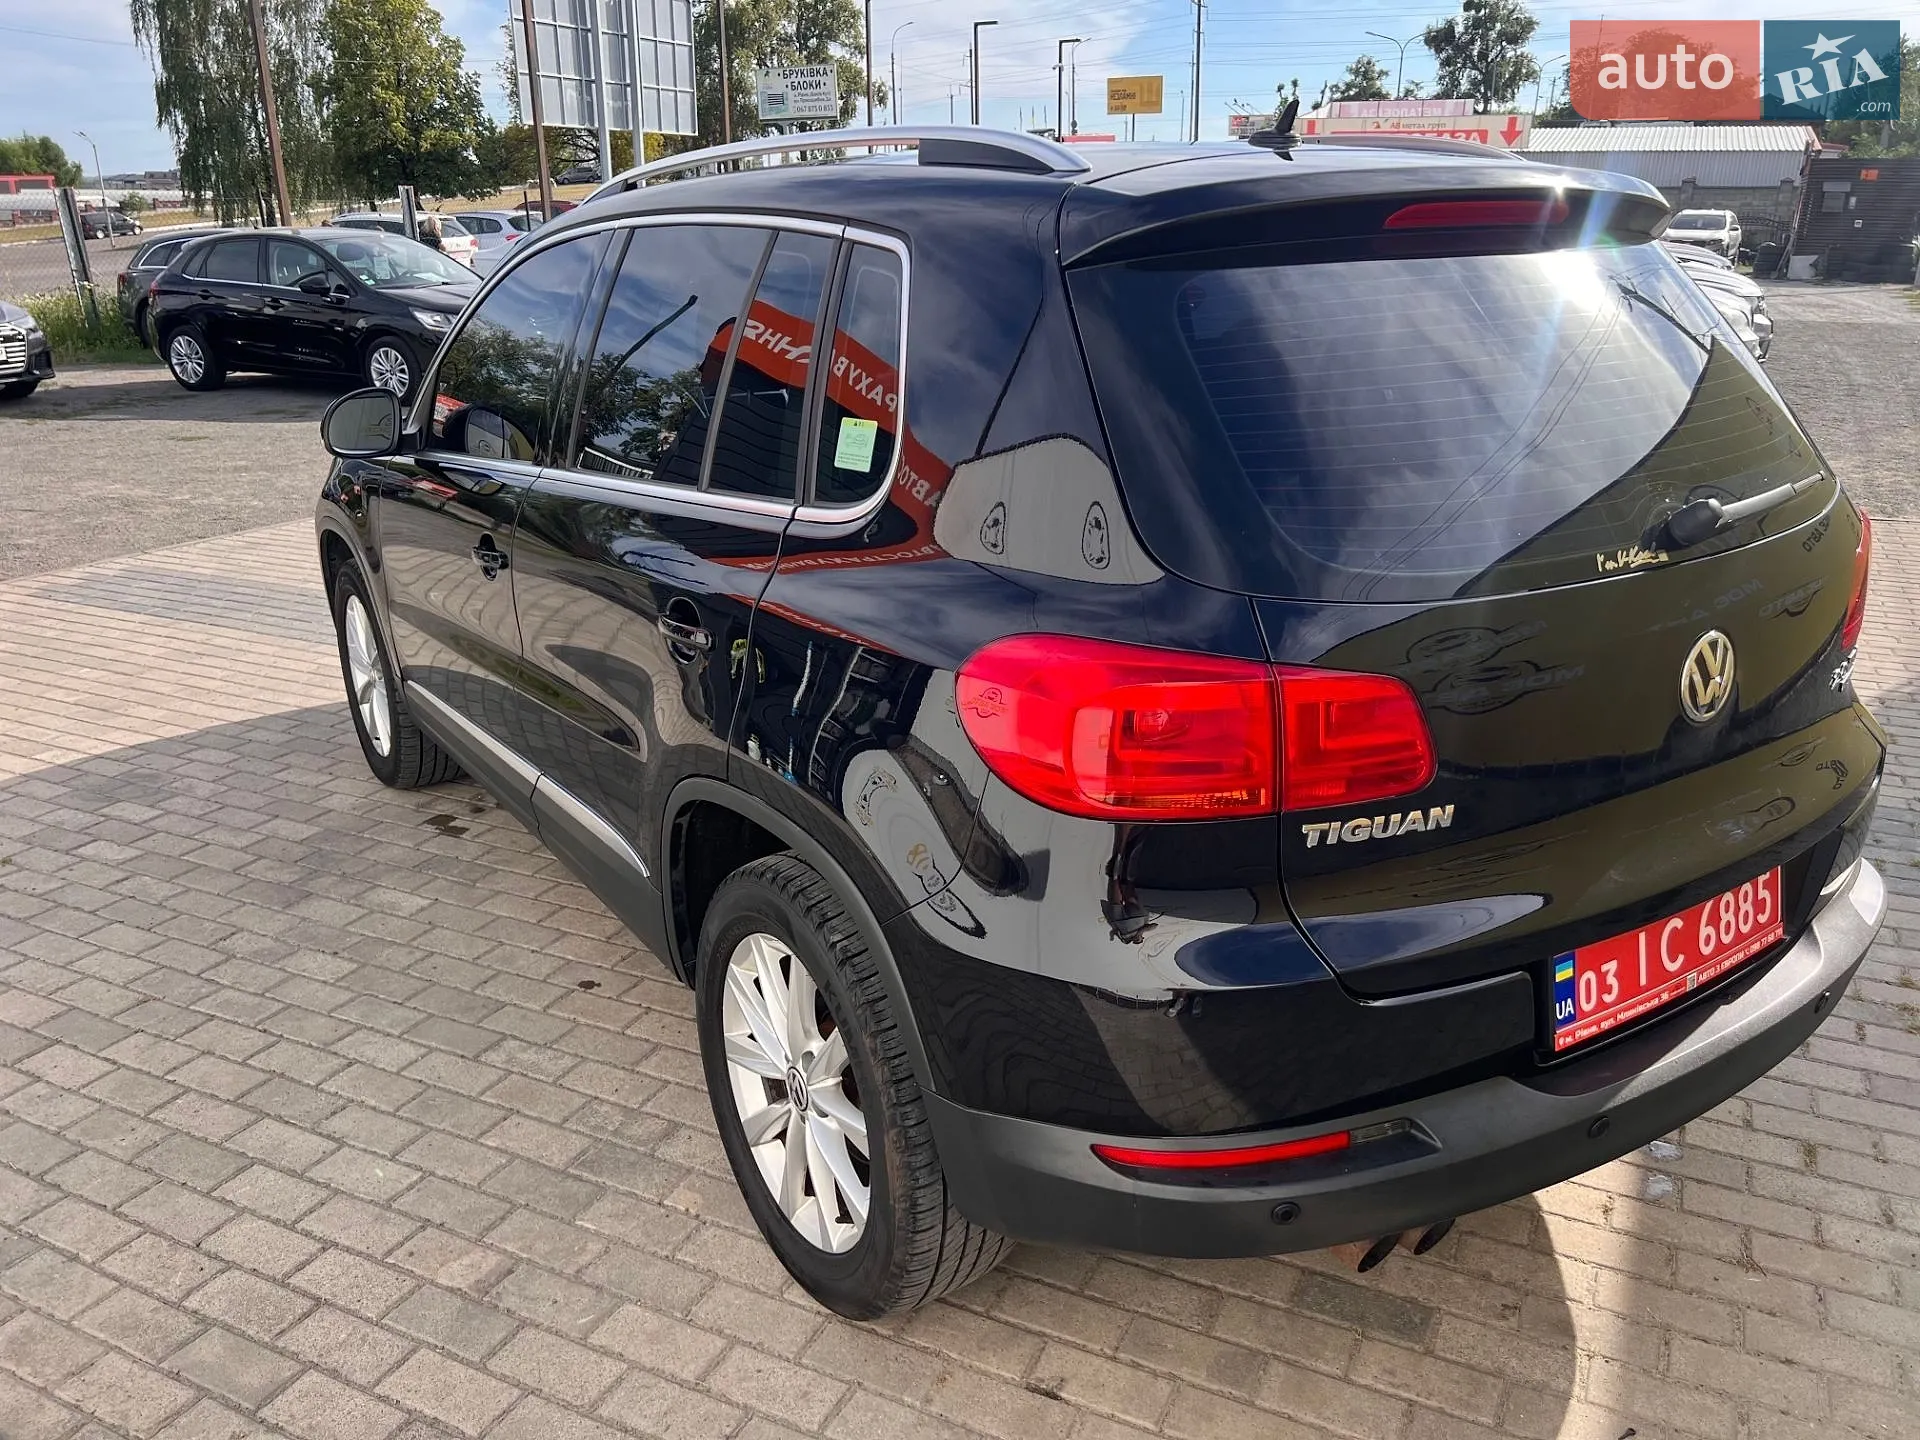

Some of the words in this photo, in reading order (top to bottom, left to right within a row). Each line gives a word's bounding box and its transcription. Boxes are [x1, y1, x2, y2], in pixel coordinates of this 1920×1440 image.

[782, 67, 828, 79] БРУКІВКА
[790, 79, 821, 91] БЛОКИ
[1301, 803, 1455, 849] TIGUAN
[1578, 959, 1619, 1012] 03
[1699, 871, 1772, 956] 6885
[1697, 966, 1715, 982] АВТО
[1555, 998, 1575, 1020] UA
